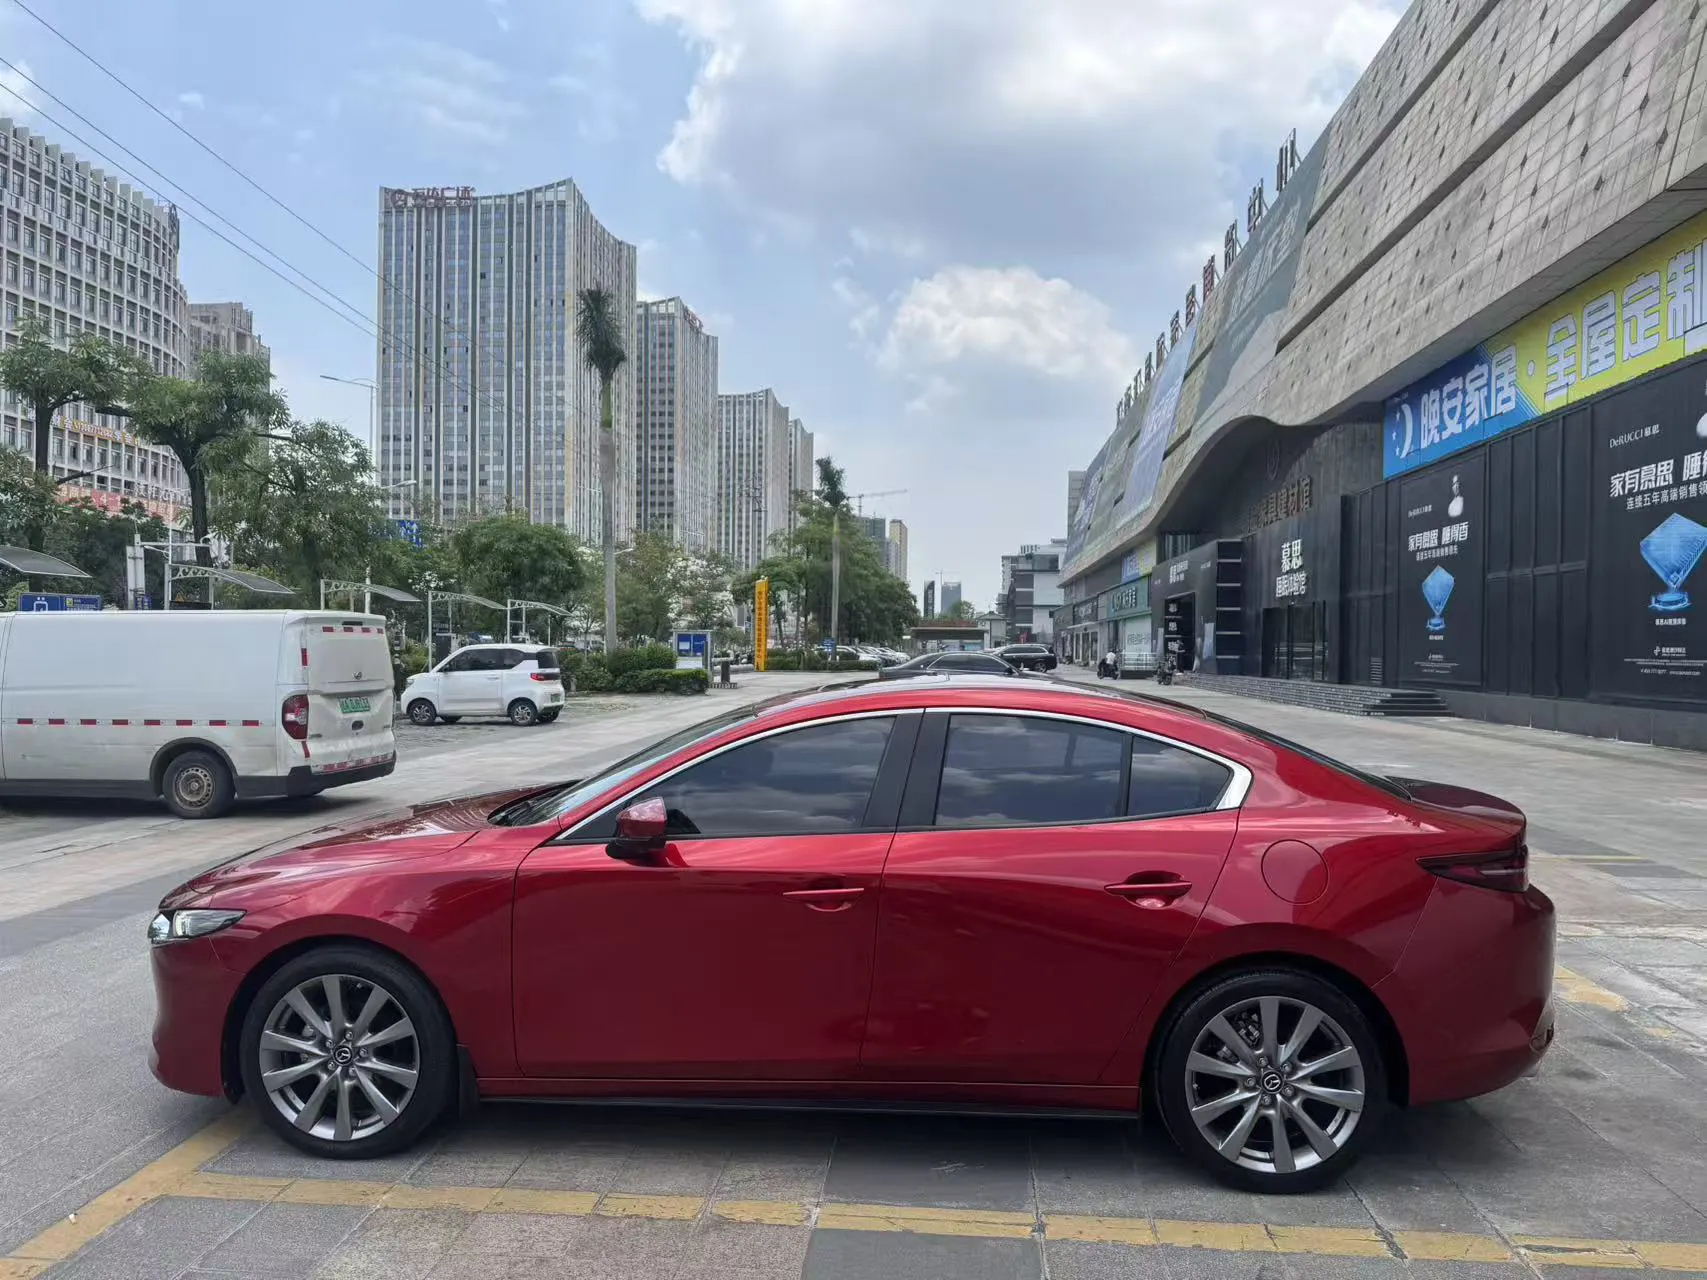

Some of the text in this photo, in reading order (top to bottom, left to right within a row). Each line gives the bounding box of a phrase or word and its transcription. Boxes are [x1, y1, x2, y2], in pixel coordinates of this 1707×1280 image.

[1421, 345, 1517, 449] 晚安家居
[1609, 428, 1643, 449] DeRUCCI
[1609, 448, 1707, 498] 家有慕思 睡
[1281, 538, 1302, 573] 慕思
